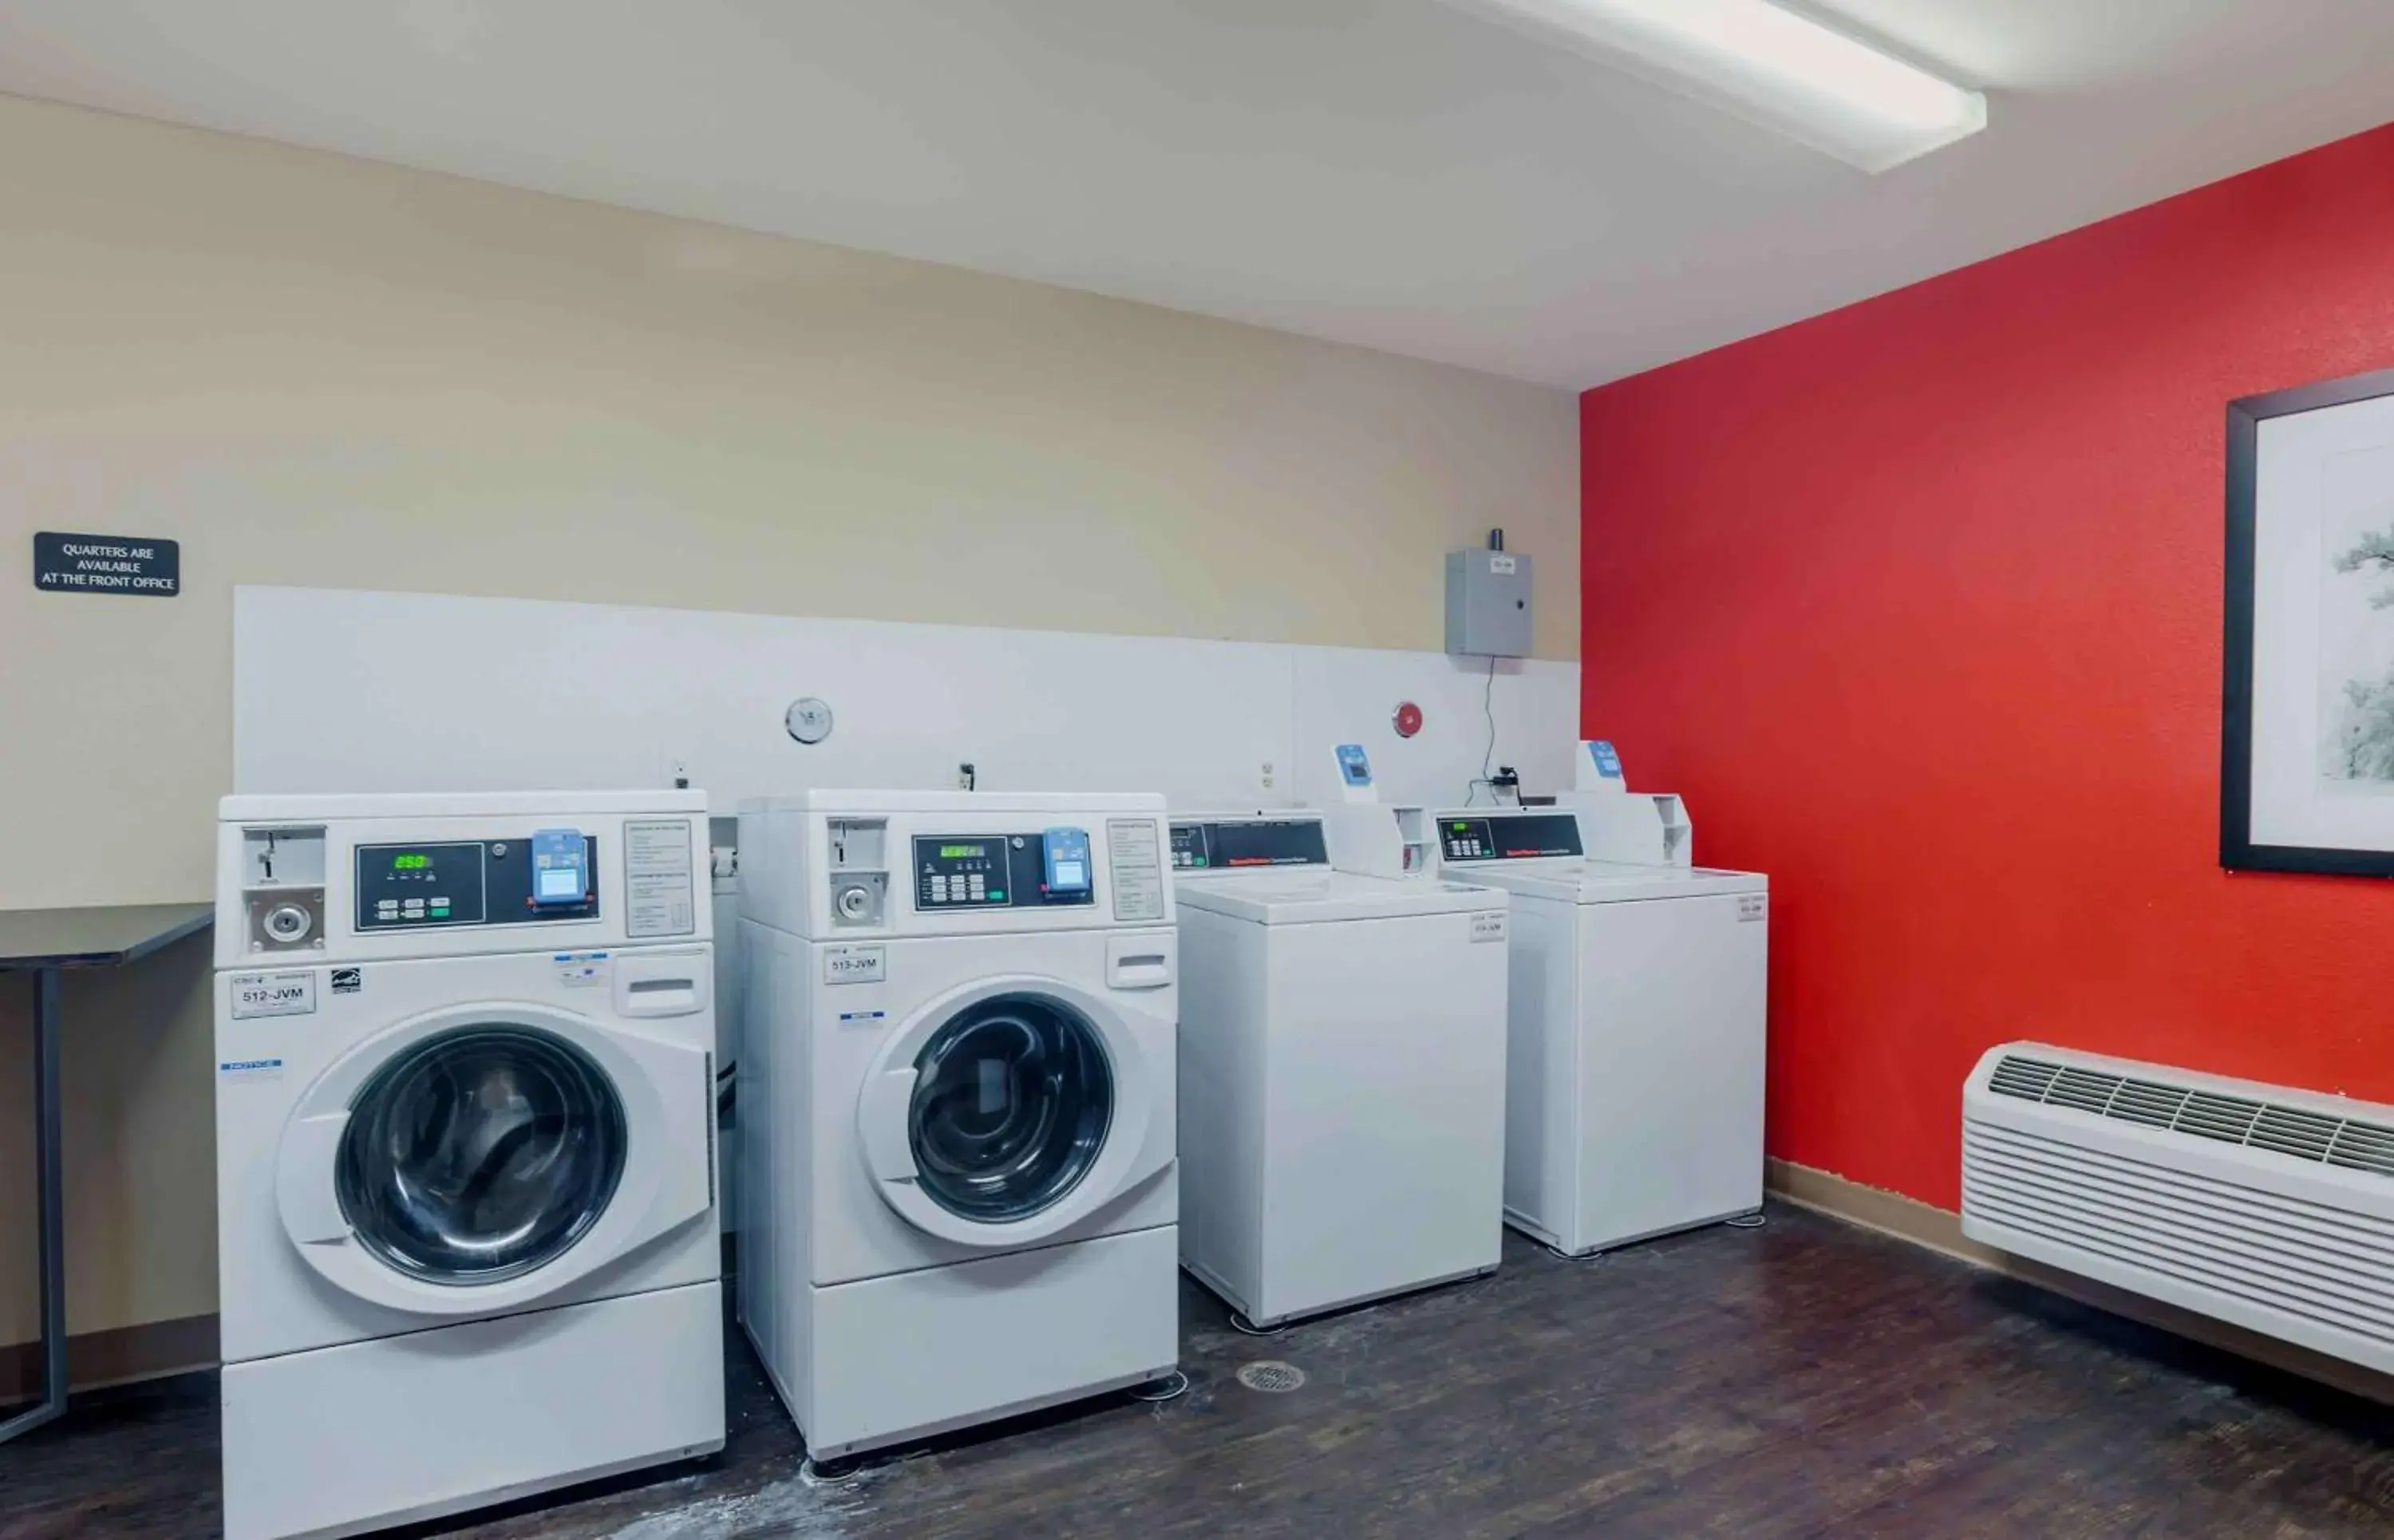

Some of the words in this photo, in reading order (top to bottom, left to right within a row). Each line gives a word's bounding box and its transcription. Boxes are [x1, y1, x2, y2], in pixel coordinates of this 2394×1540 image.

[62, 543, 128, 559] QUARTERS
[130, 548, 154, 559] ARE
[77, 560, 141, 573] AVAILABLE
[41, 573, 61, 584] AT
[62, 574, 87, 585] THE
[89, 575, 131, 587] FRONT
[132, 577, 176, 590] OFFICE
[243, 988, 303, 1002] 512-JVM
